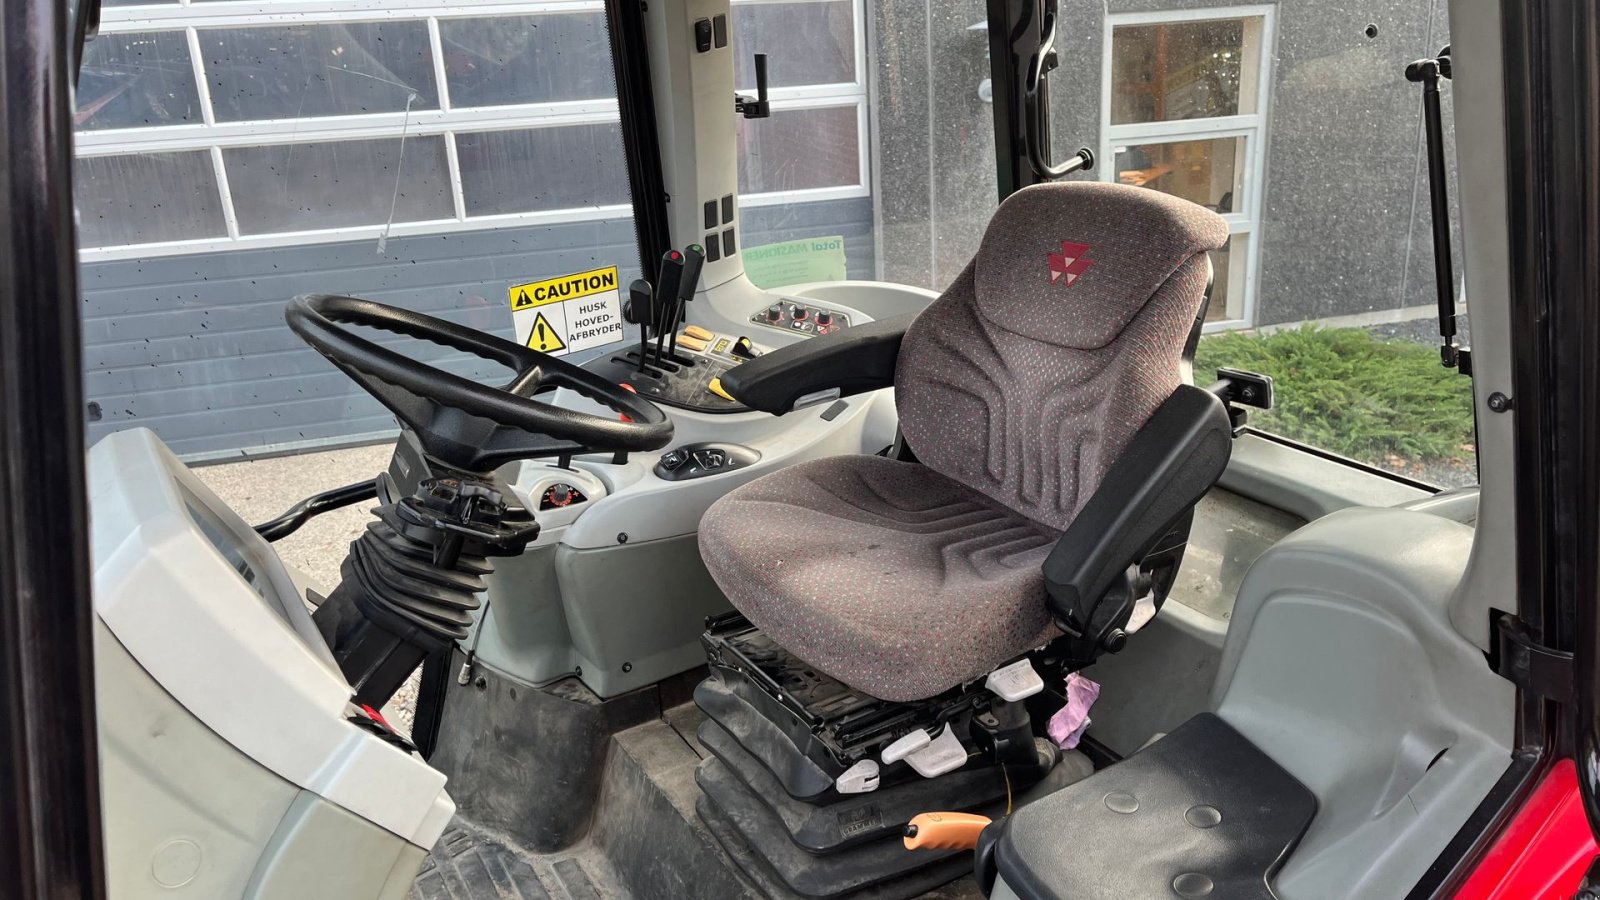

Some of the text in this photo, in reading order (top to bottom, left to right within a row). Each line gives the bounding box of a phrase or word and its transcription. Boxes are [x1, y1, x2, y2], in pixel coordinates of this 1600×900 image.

[534, 272, 614, 301] CAUTION
[579, 301, 607, 314] HUSK
[575, 314, 614, 328] HOVED-
[569, 322, 622, 342] AFBRYDER
